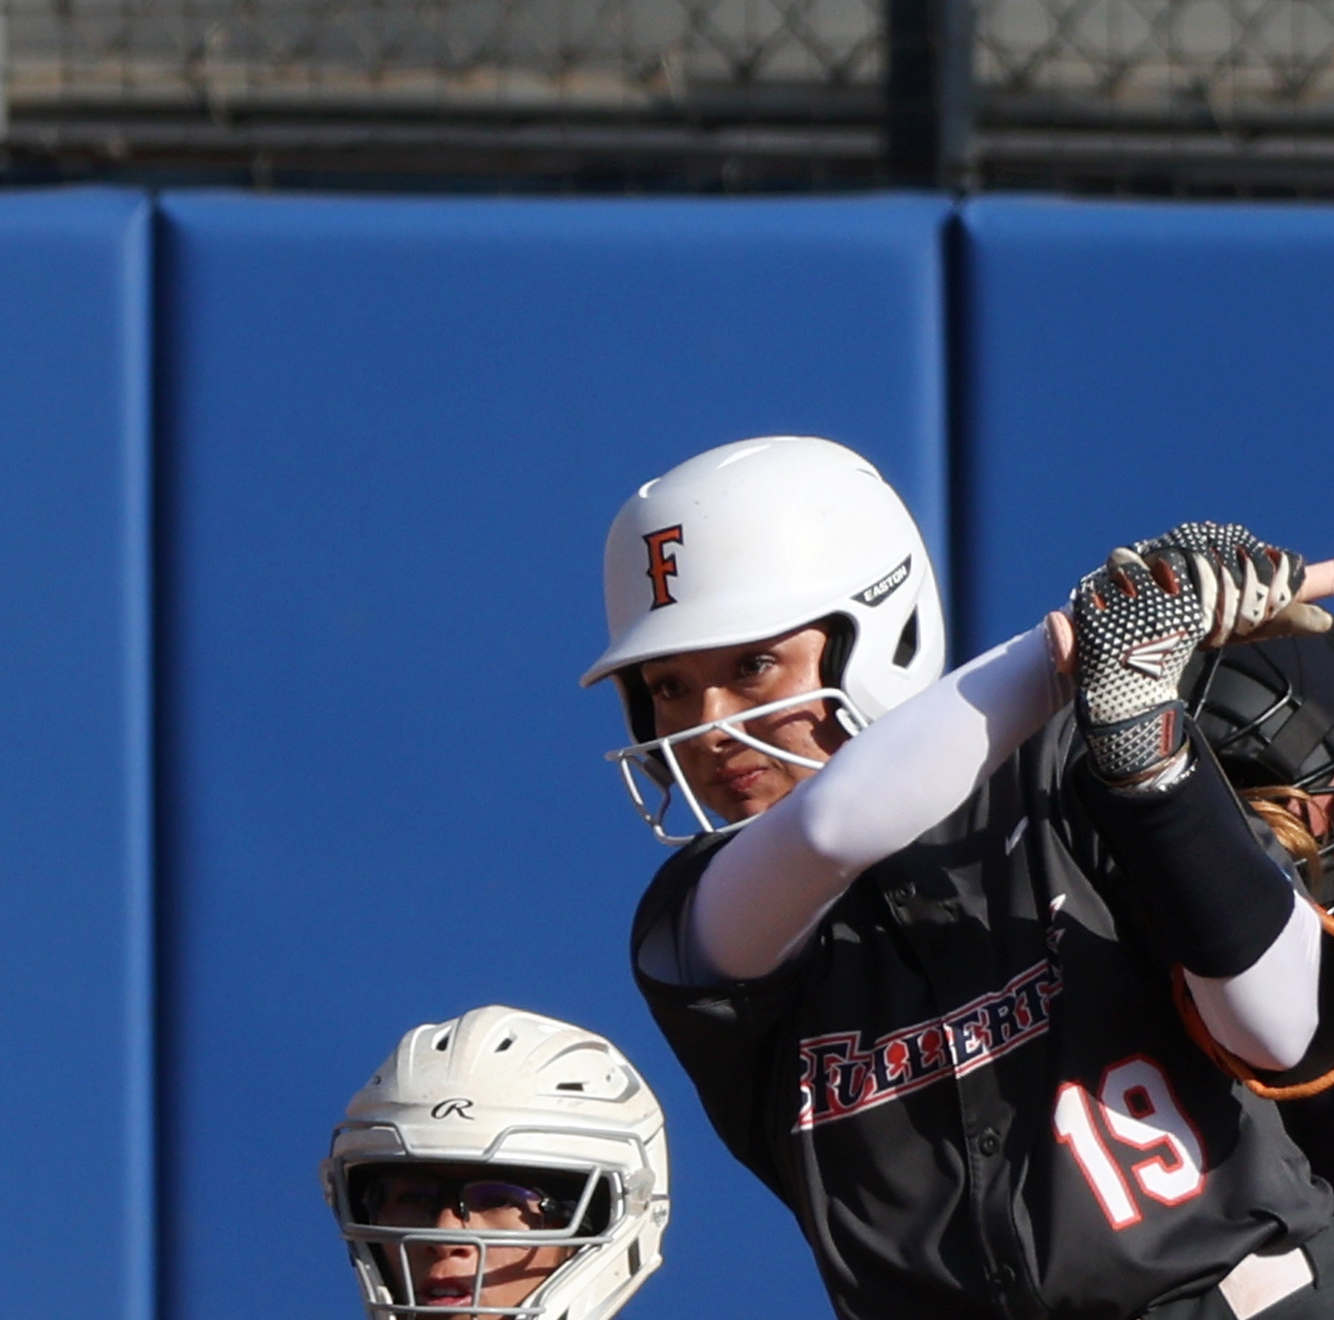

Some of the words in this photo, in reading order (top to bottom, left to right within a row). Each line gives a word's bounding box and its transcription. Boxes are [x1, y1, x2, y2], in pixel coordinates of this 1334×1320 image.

[641, 522, 685, 612] F
[863, 564, 908, 602] EASTON
[797, 959, 1063, 1130] FULLERT
[1051, 1051, 1210, 1231] 19
